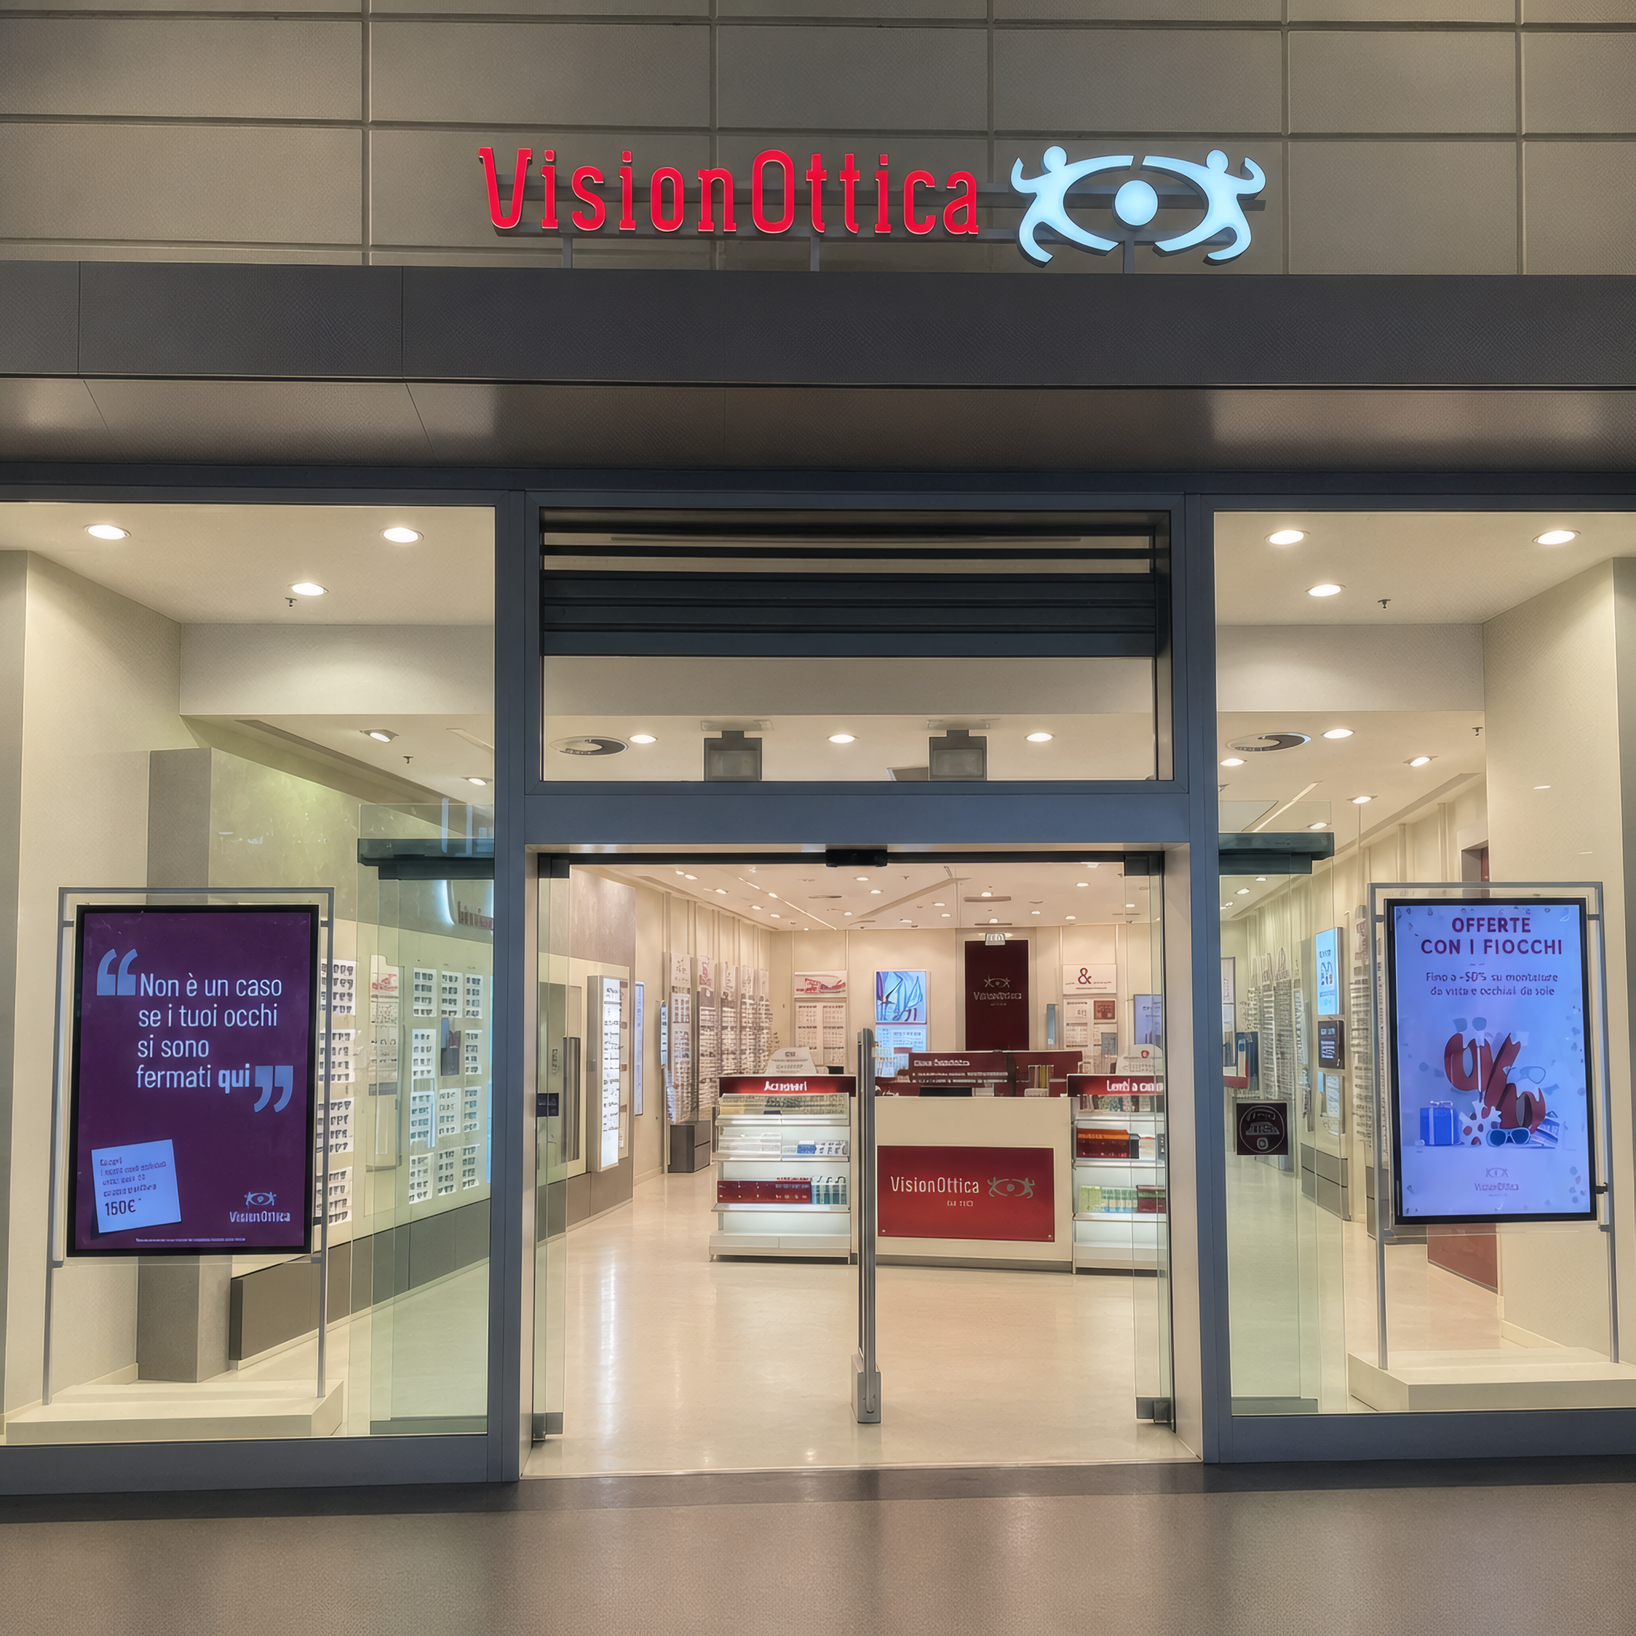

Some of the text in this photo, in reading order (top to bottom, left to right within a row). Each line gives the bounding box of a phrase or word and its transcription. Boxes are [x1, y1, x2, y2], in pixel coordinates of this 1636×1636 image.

[478, 146, 980, 234] VisionOttica
[1451, 917, 1531, 934] OFFERTE
[1420, 938, 1562, 955] CON I FIOCCHI
[140, 971, 282, 997] Non è un caso
[138, 1003, 278, 1028] se i tuoi occhi
[137, 1034, 210, 1058] si sono
[136, 1064, 212, 1089] fermati
[890, 1175, 980, 1194] VisionOttica
